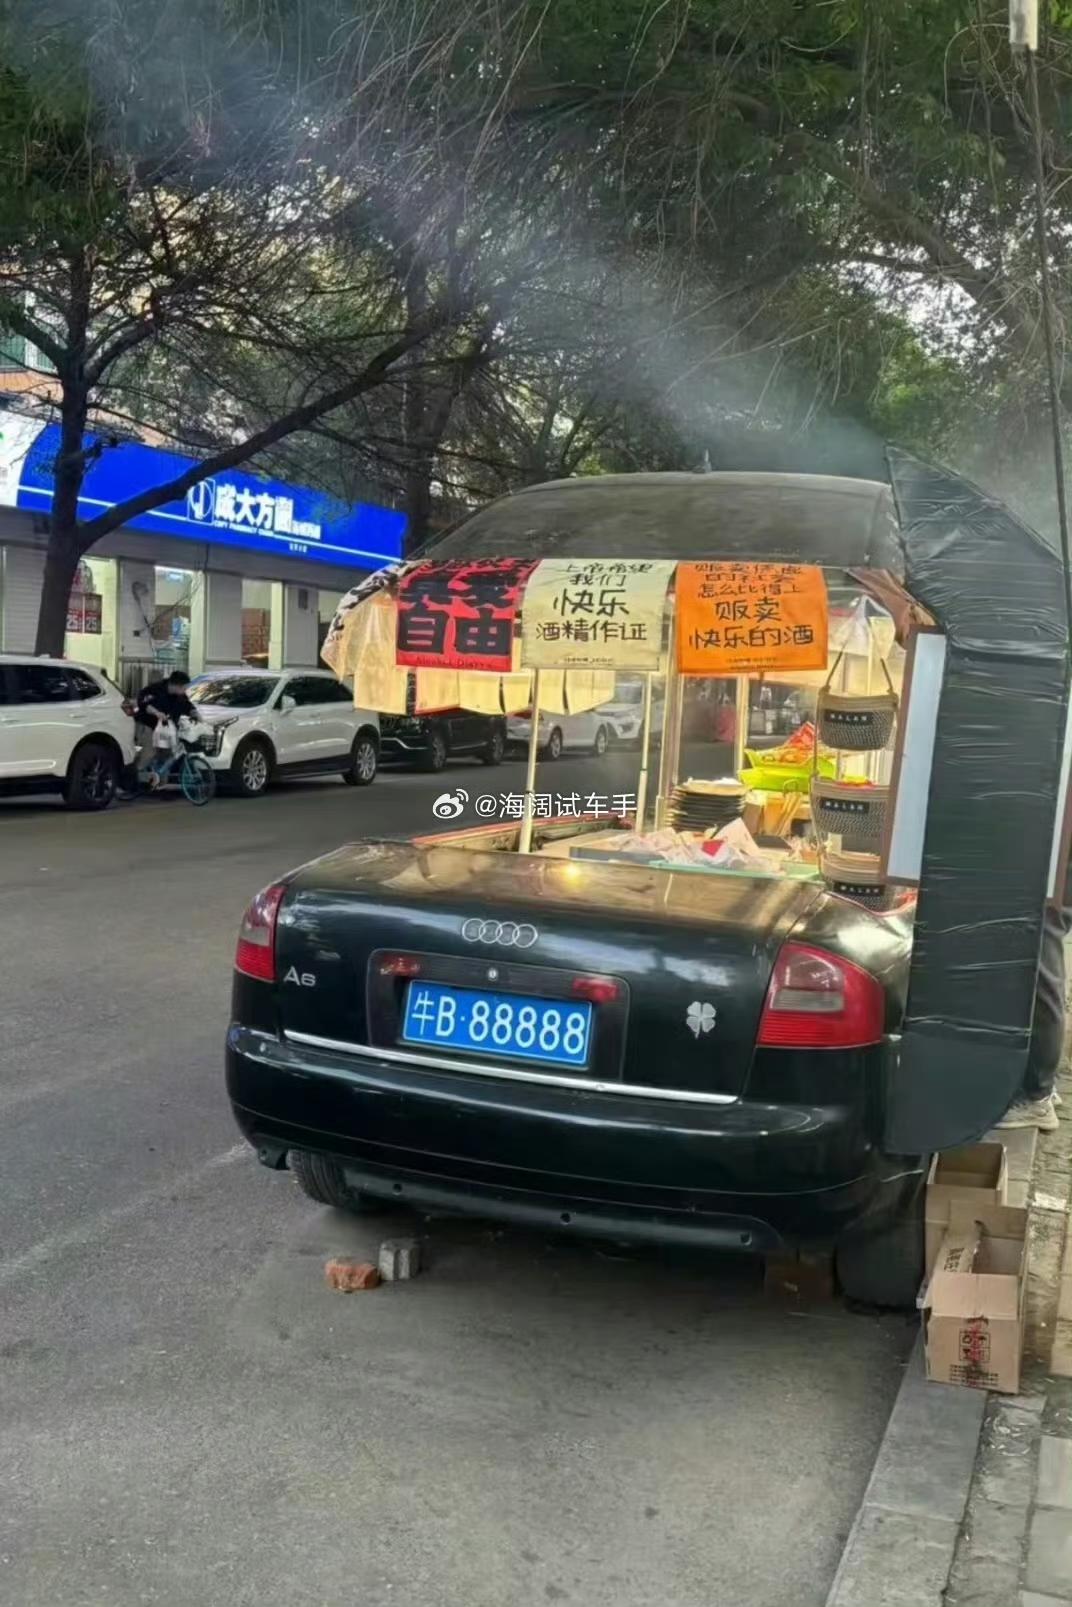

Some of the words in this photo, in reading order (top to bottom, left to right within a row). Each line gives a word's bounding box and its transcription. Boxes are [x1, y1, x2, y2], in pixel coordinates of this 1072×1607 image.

[569, 573, 627, 587] 我们
[698, 582, 803, 599] 怎么比得上
[553, 588, 630, 617] 快乐
[714, 596, 782, 623] 贩卖
[397, 600, 513, 657] 自由
[536, 617, 648, 643] 酒精作证
[688, 623, 815, 650] 快乐的酒
[284, 965, 316, 987] A6
